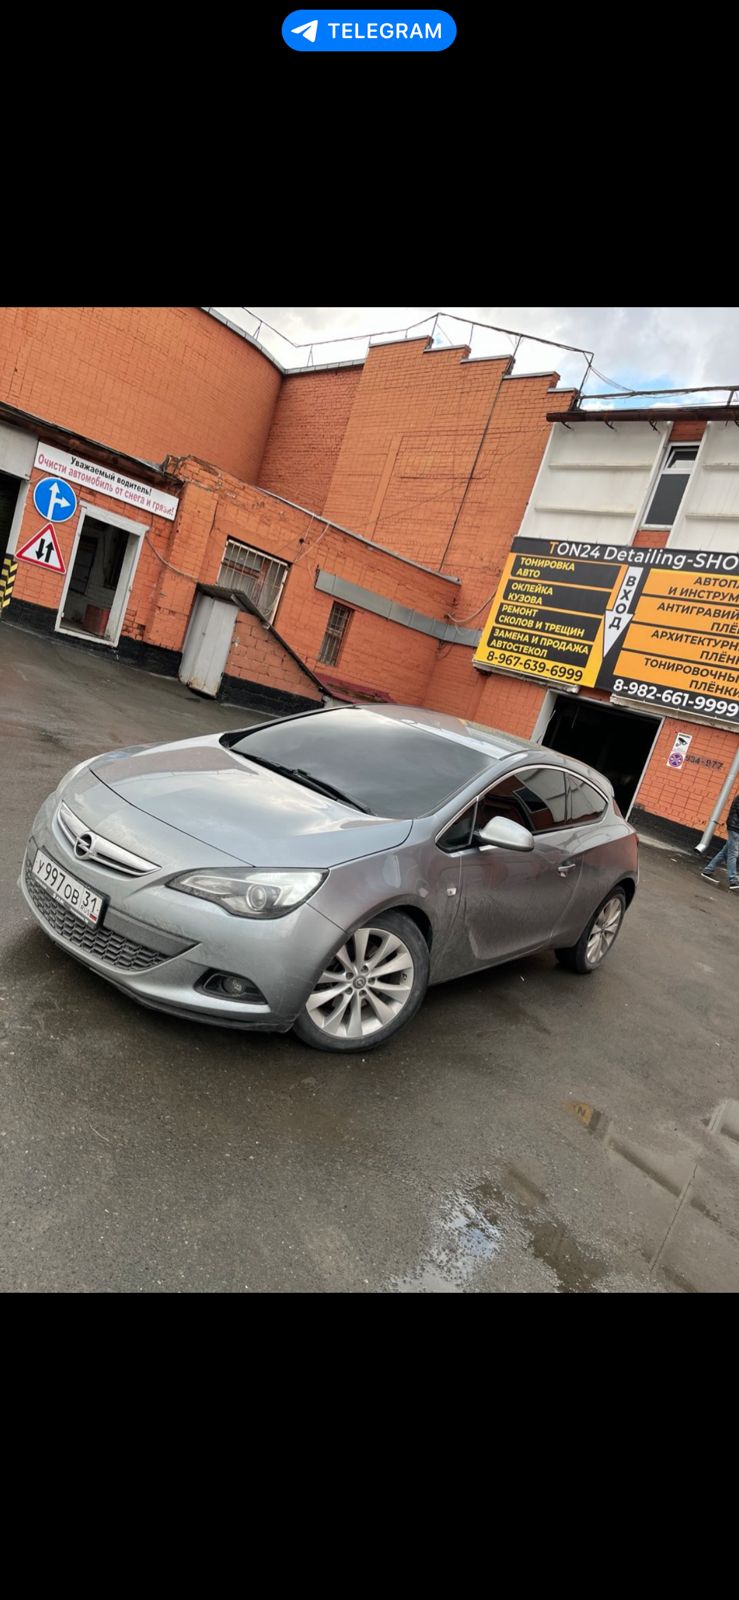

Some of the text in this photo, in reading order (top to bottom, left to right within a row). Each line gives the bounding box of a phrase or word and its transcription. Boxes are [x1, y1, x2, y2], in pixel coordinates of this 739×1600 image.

[38, 454, 67, 474] Очисти
[68, 468, 114, 493] автомобиль
[115, 487, 124, 496] от
[124, 490, 145, 504] снега
[71, 457, 152, 496] Уважаемый водитель!
[549, 541, 601, 560] TON24
[516, 568, 541, 578] АВТО
[520, 557, 575, 571] ТОНИРОВКА
[511, 582, 553, 596] ОКЛЕЙКА
[668, 586, 678, 596] И
[694, 577, 739, 589] АВТОП
[508, 592, 543, 605] КУЗОВА
[501, 604, 538, 617] РЕМОНТ
[498, 614, 585, 638] СКОЛОВ И ТРЕЩИН
[710, 622, 739, 635] ПЛЁ
[490, 639, 548, 658] АВТОСТЕКОЛ
[493, 628, 589, 655] ЗАМЕНА И ПРОДАЖА
[651, 630, 739, 651] АРХИТЕКТУРН
[486, 651, 583, 682] 8-967-639-6999
[613, 679, 739, 717] 8-982-661-9999
[83, 891, 97, 912] 31
